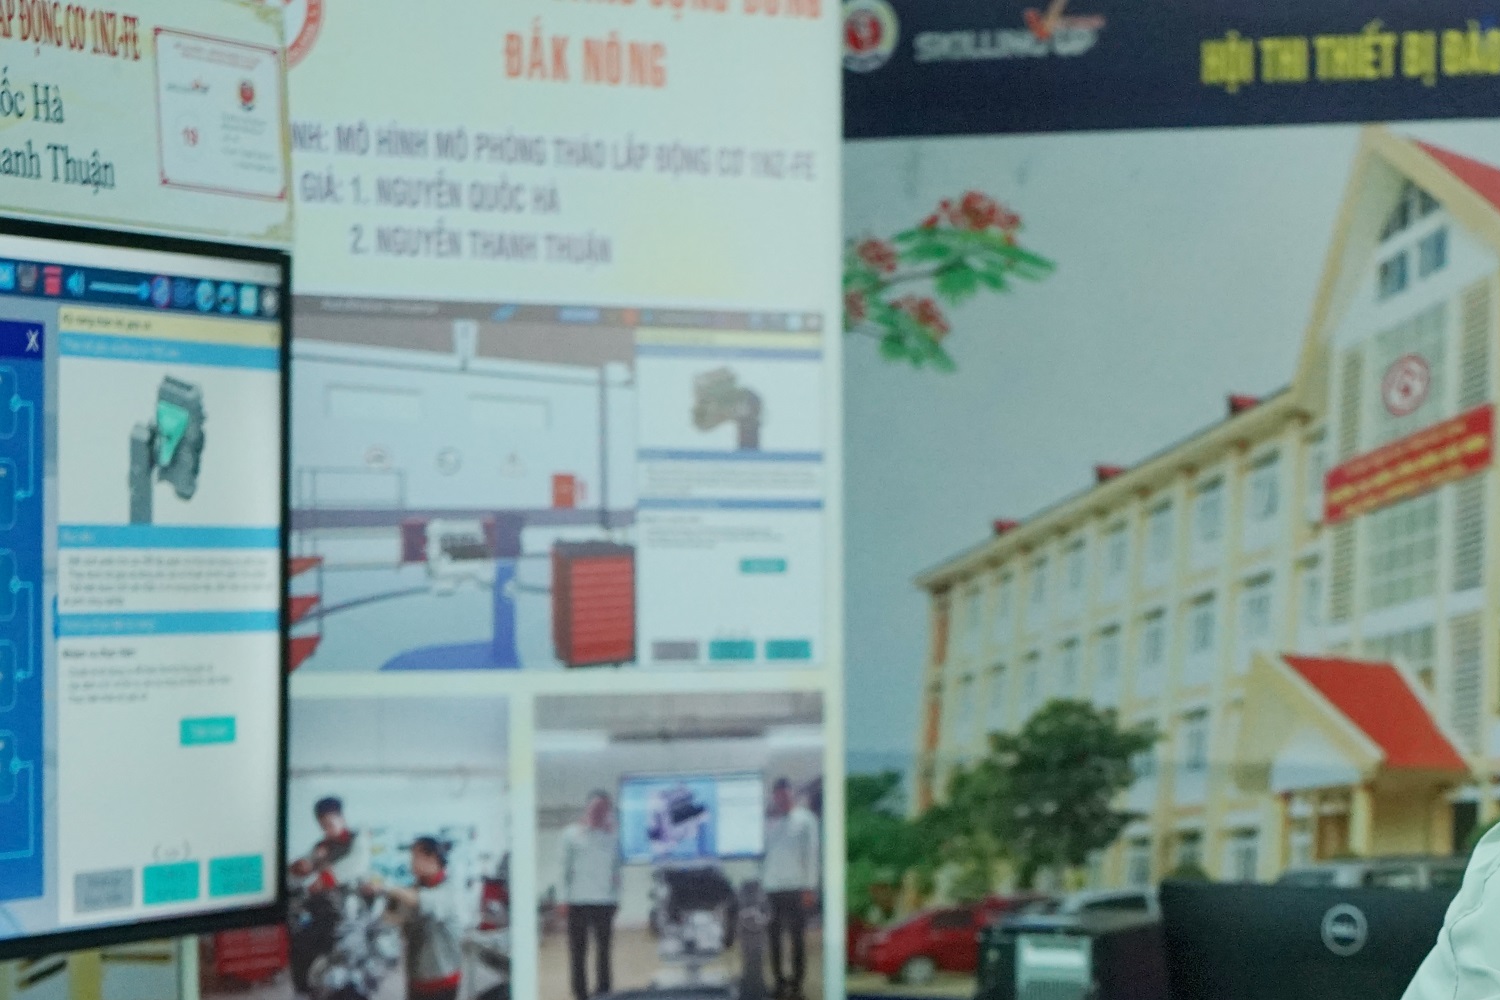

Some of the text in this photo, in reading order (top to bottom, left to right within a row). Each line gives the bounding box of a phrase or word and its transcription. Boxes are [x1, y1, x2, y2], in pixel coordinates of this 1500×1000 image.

[582, 30, 667, 88] NÔNG
[32, 82, 65, 124] Hà
[335, 119, 369, 156] MÔ
[433, 126, 469, 162] MÔ
[46, 142, 115, 195] Thuận
[467, 229, 539, 261] THANH
